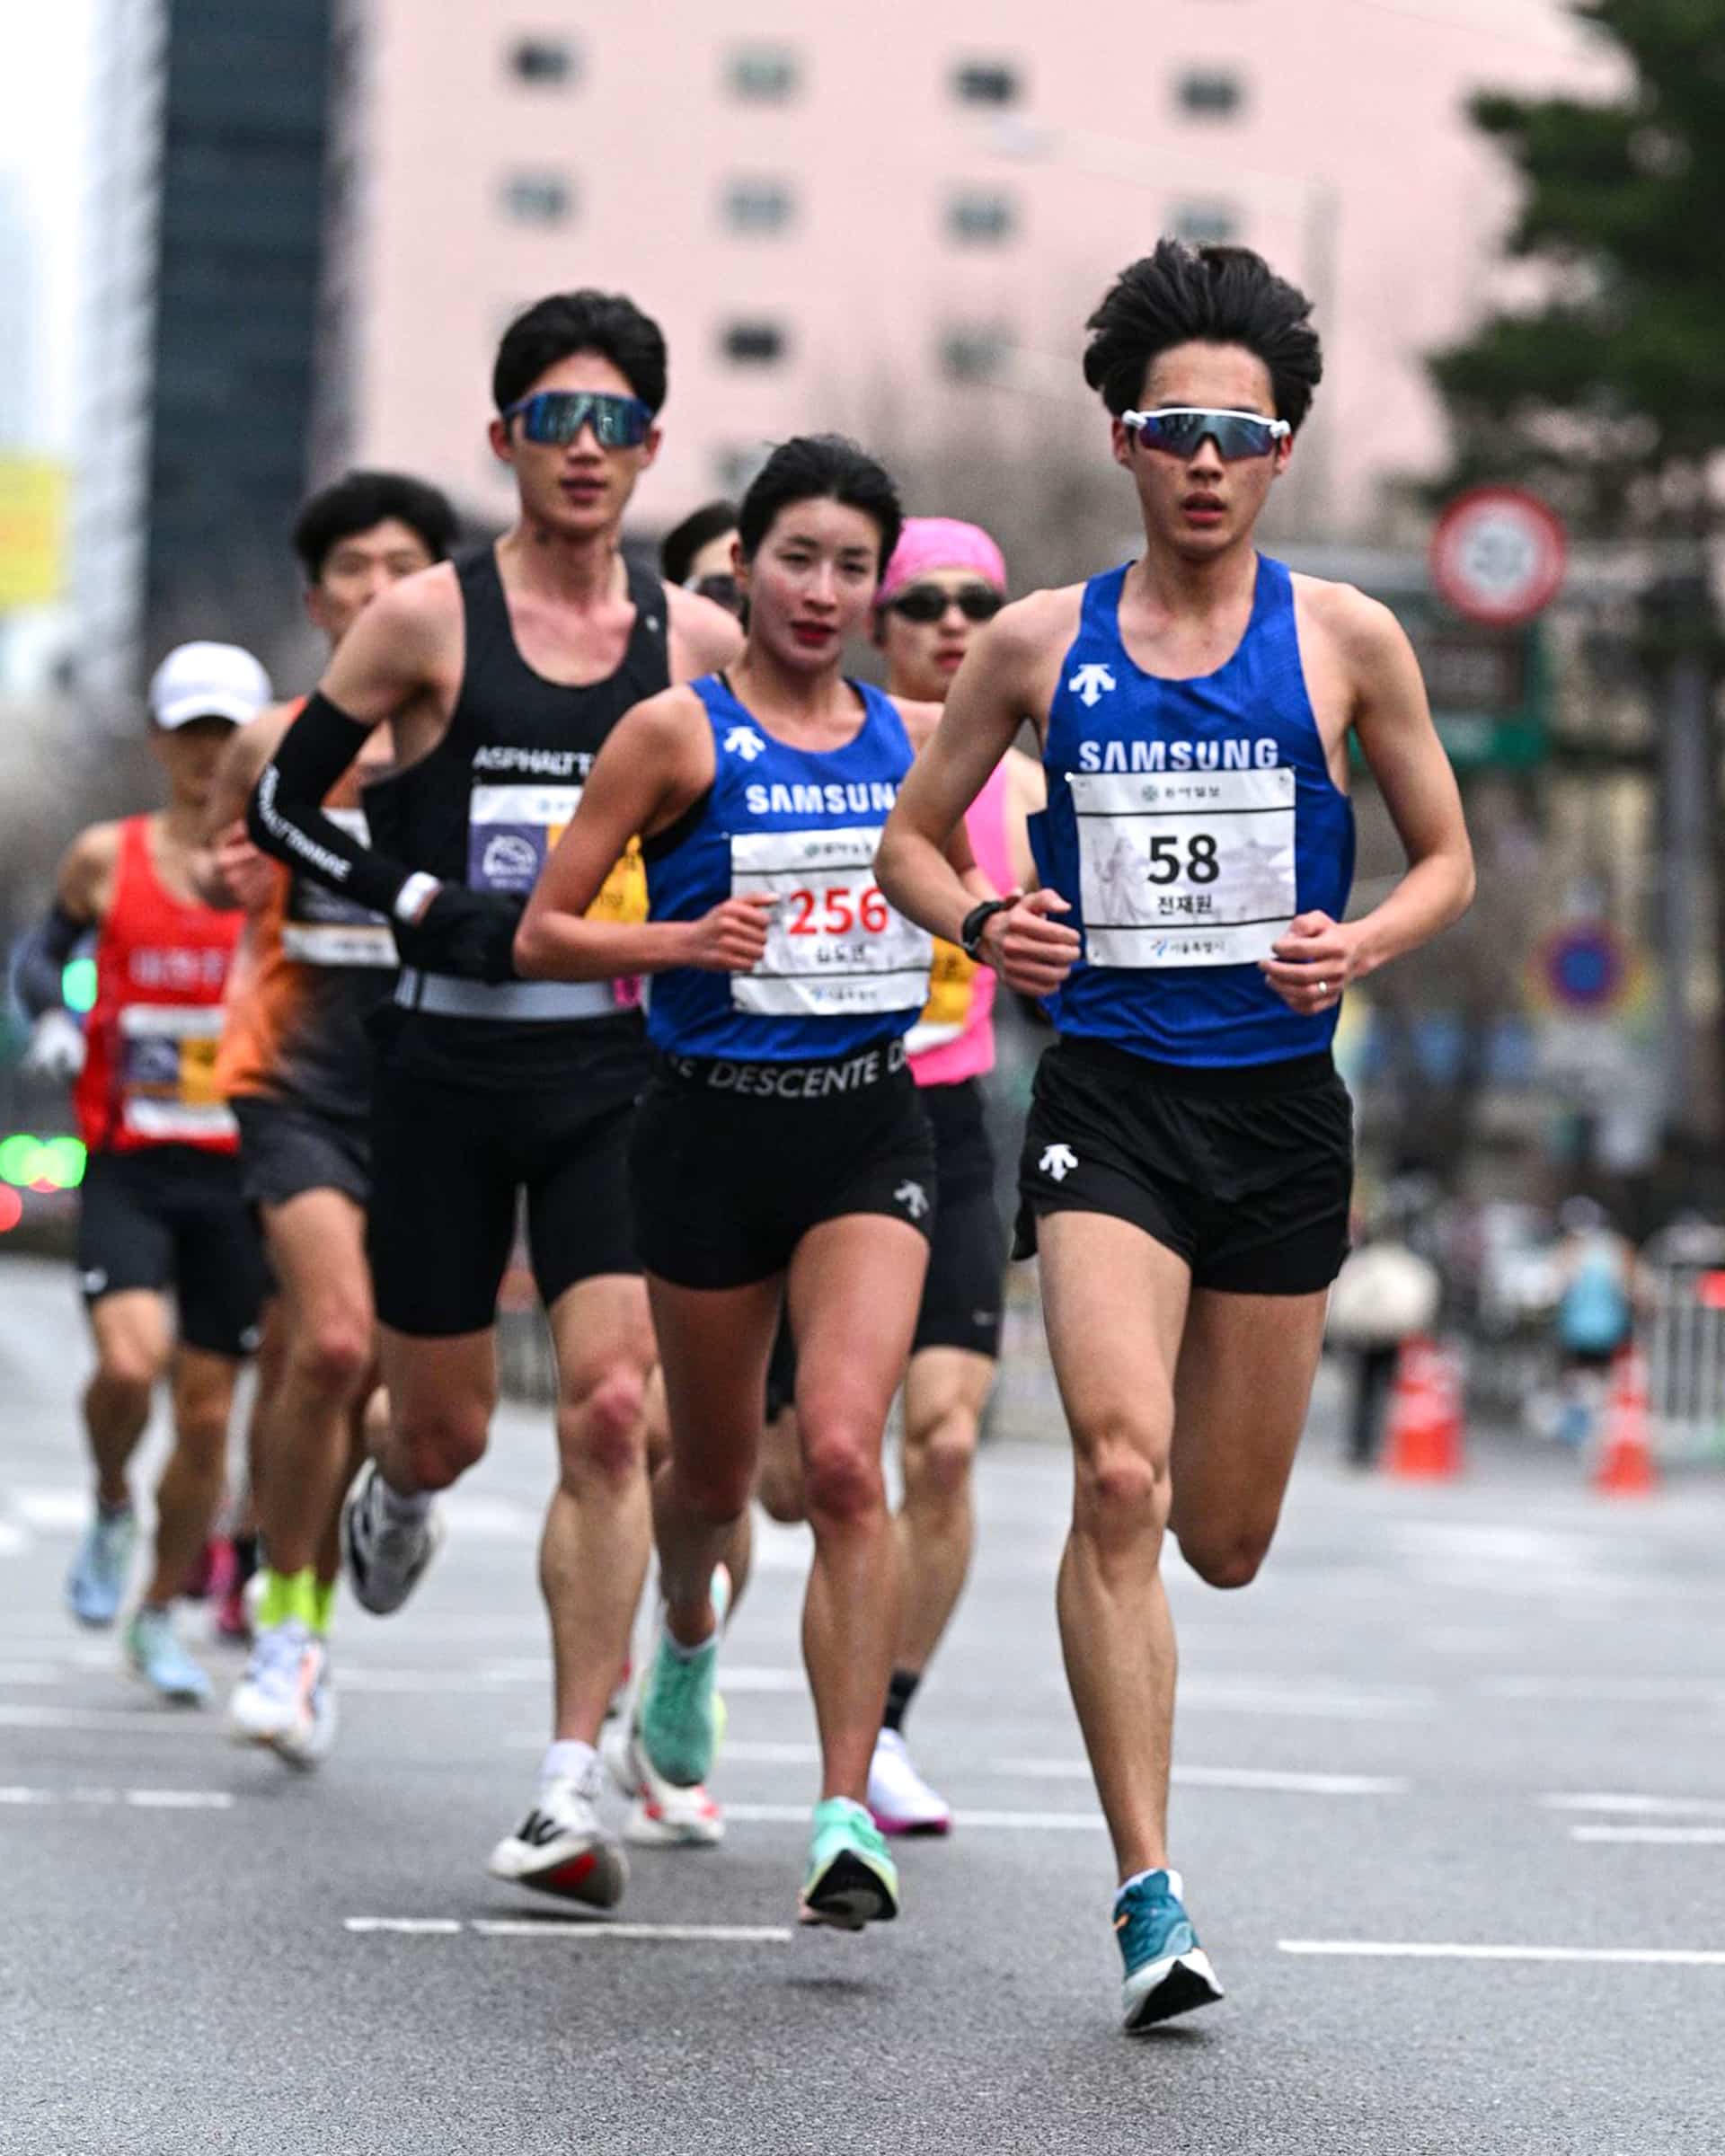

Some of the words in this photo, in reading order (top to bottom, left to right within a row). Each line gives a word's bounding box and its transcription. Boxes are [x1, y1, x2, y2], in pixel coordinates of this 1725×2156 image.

[1078, 738, 1279, 772] SAMSUNG
[745, 782, 901, 814] SAMSUN
[1147, 834, 1220, 884] 58
[787, 885, 889, 935] 256
[707, 1049, 881, 1098] DESCENTE
